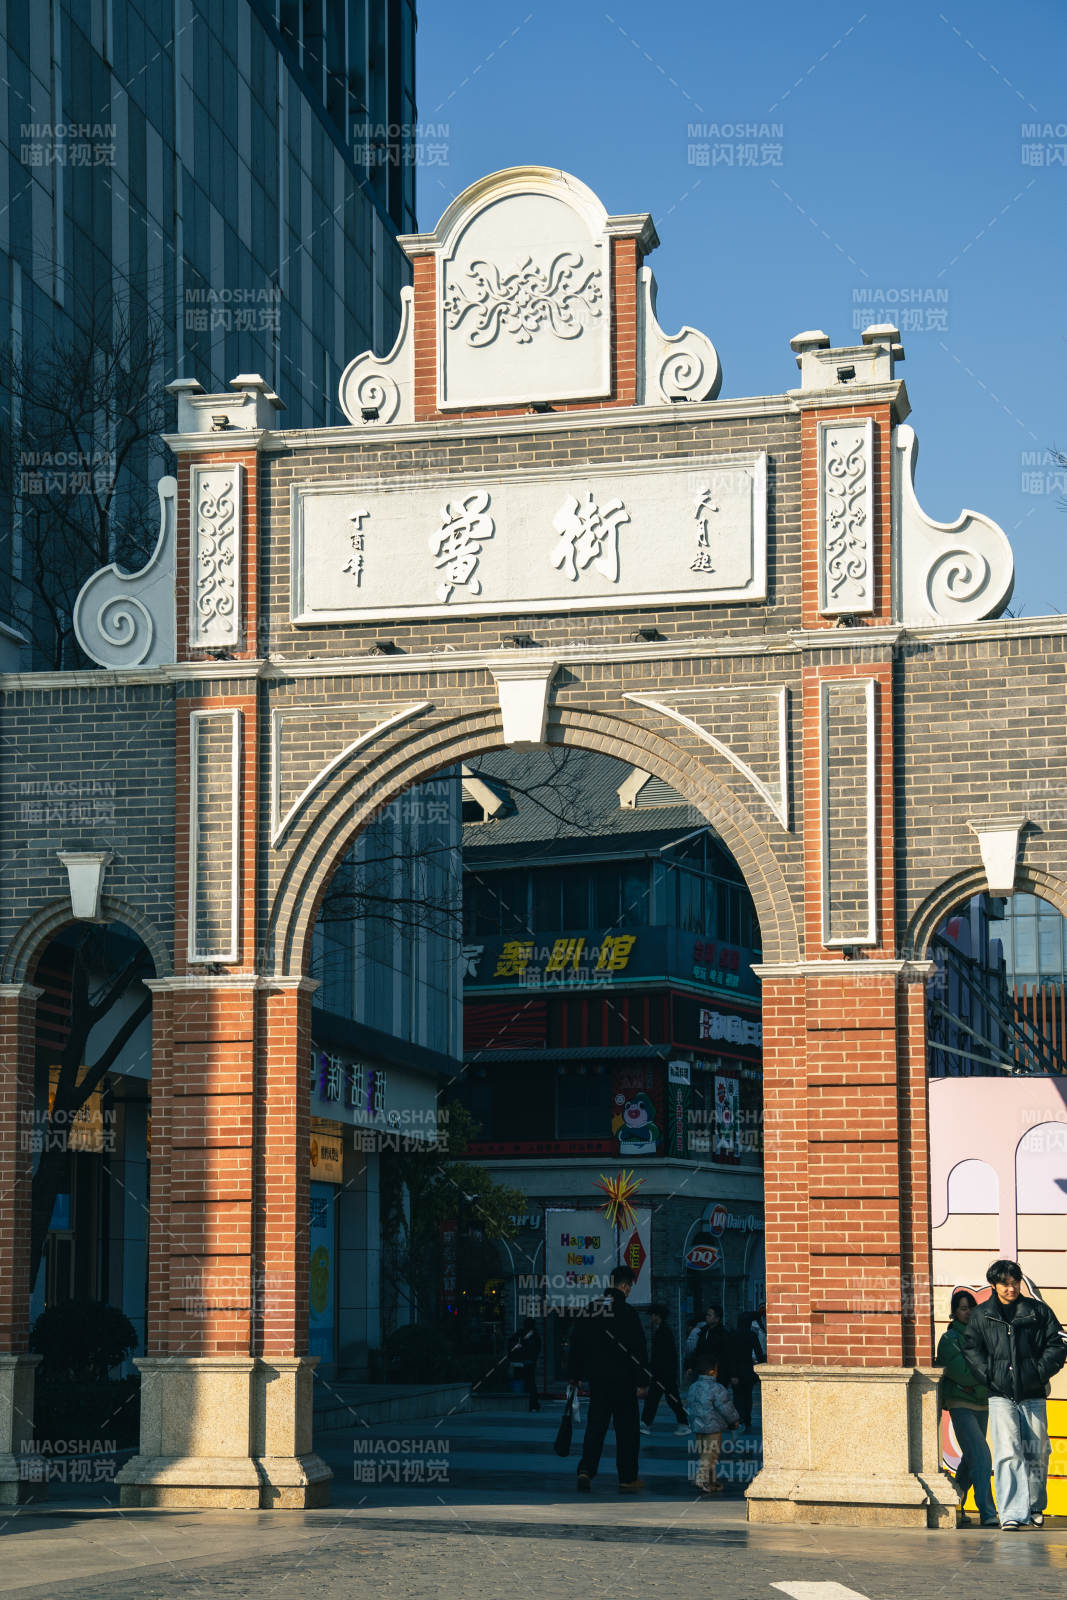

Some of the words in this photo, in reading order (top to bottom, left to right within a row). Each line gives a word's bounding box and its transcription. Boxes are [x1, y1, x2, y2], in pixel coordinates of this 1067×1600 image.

[713, 1212, 727, 1229] DQ
[560, 1233, 601, 1249] Happy
[567, 1252, 594, 1266] New
[691, 1250, 713, 1265] DQ
